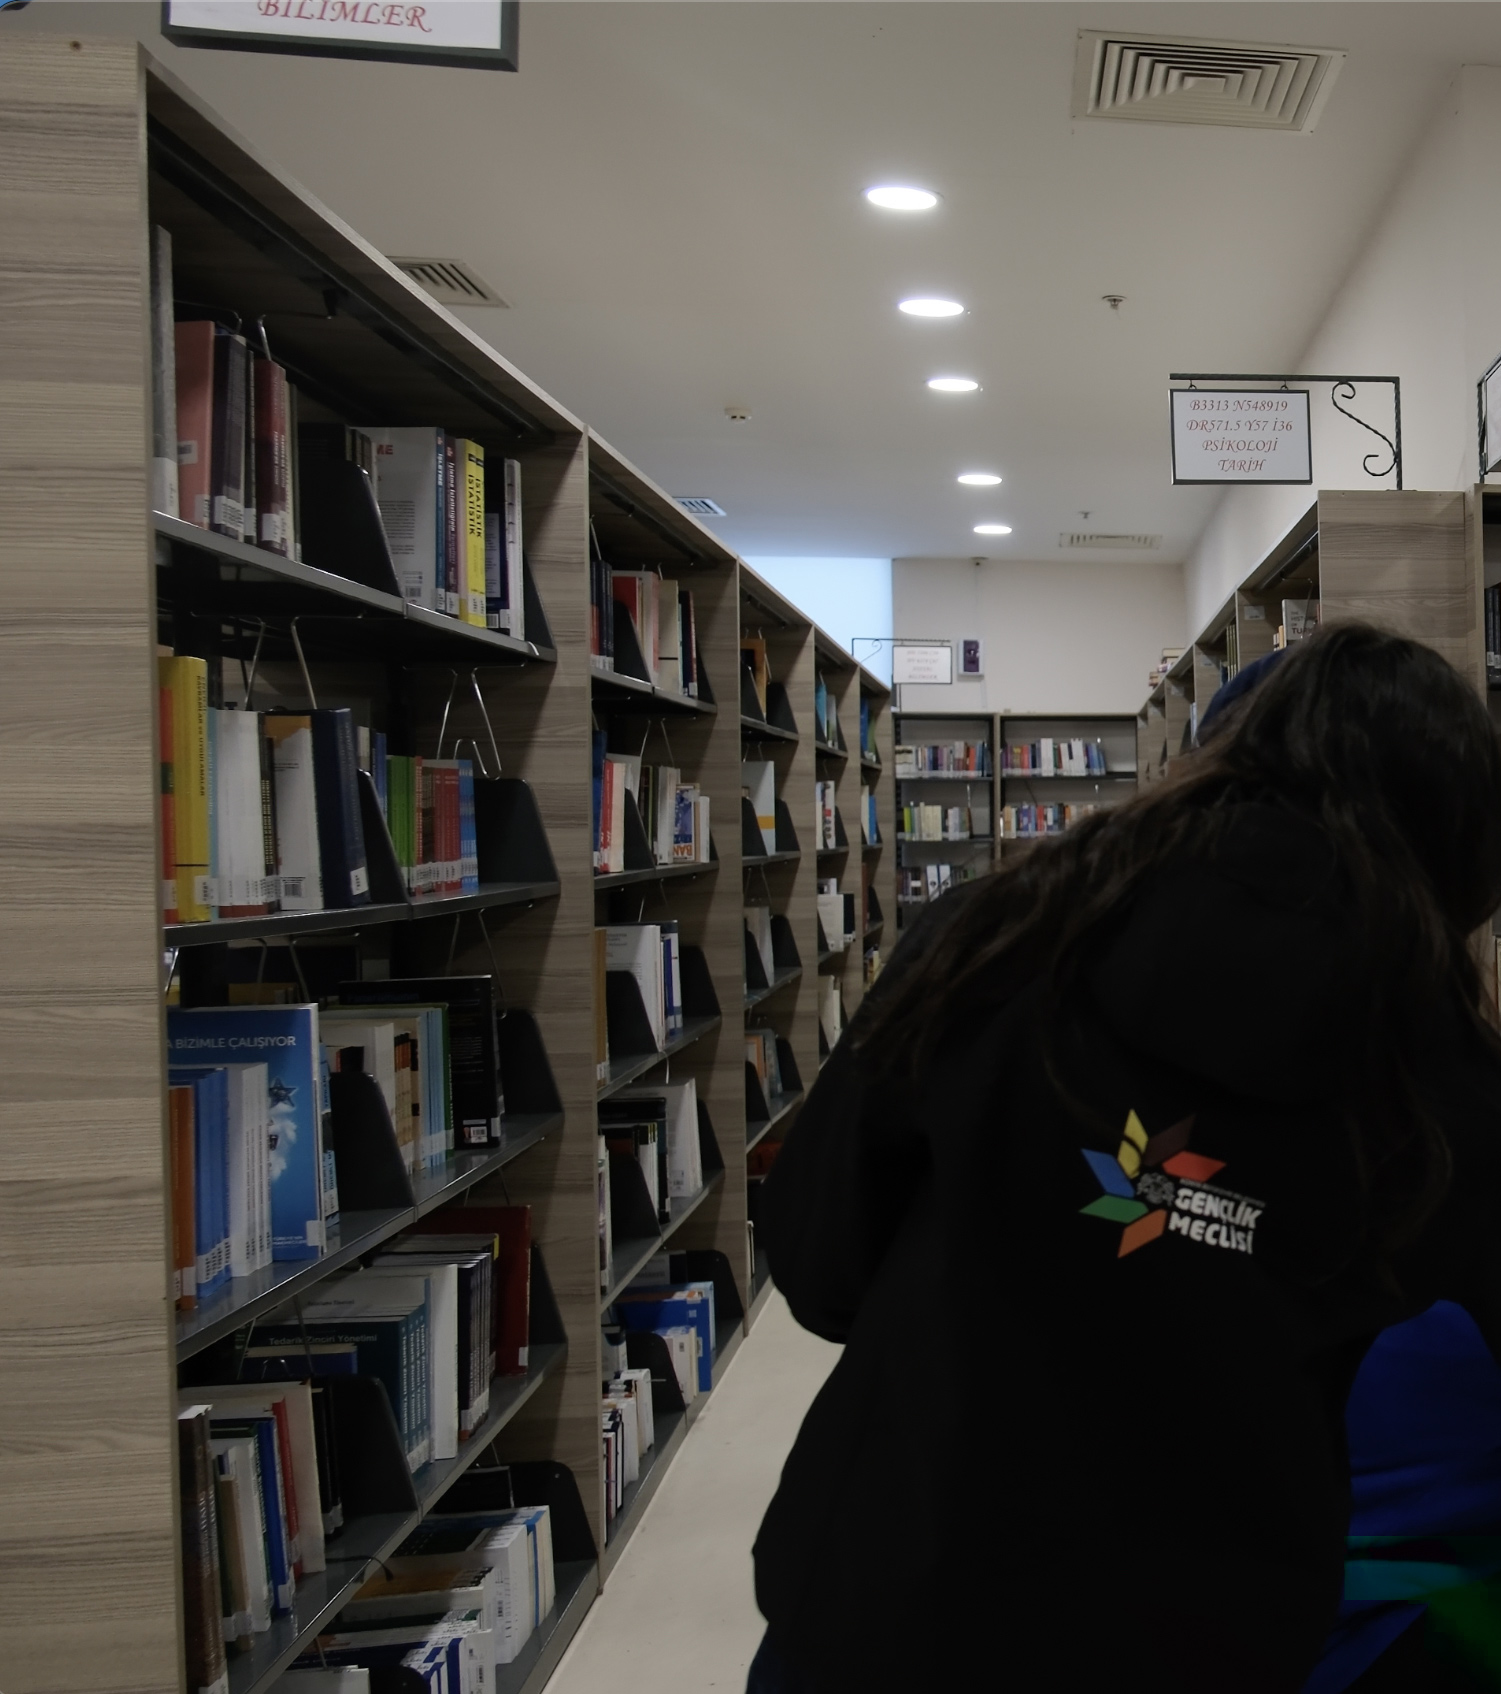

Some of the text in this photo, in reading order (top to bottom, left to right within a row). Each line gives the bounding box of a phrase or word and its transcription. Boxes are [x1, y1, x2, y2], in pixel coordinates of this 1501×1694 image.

[1190, 399, 1288, 411] B3313 N548919
[1186, 419, 1241, 433] DR571.5
[1244, 419, 1269, 431] Y57
[1202, 437, 1278, 453] PSİKOLOJİ
[1217, 457, 1266, 473] TARİH
[175, 1036, 225, 1055] BİZİMLE
[228, 1035, 298, 1057] ÇALIŞIYOR
[1175, 1187, 1263, 1229] GENÇLİK
